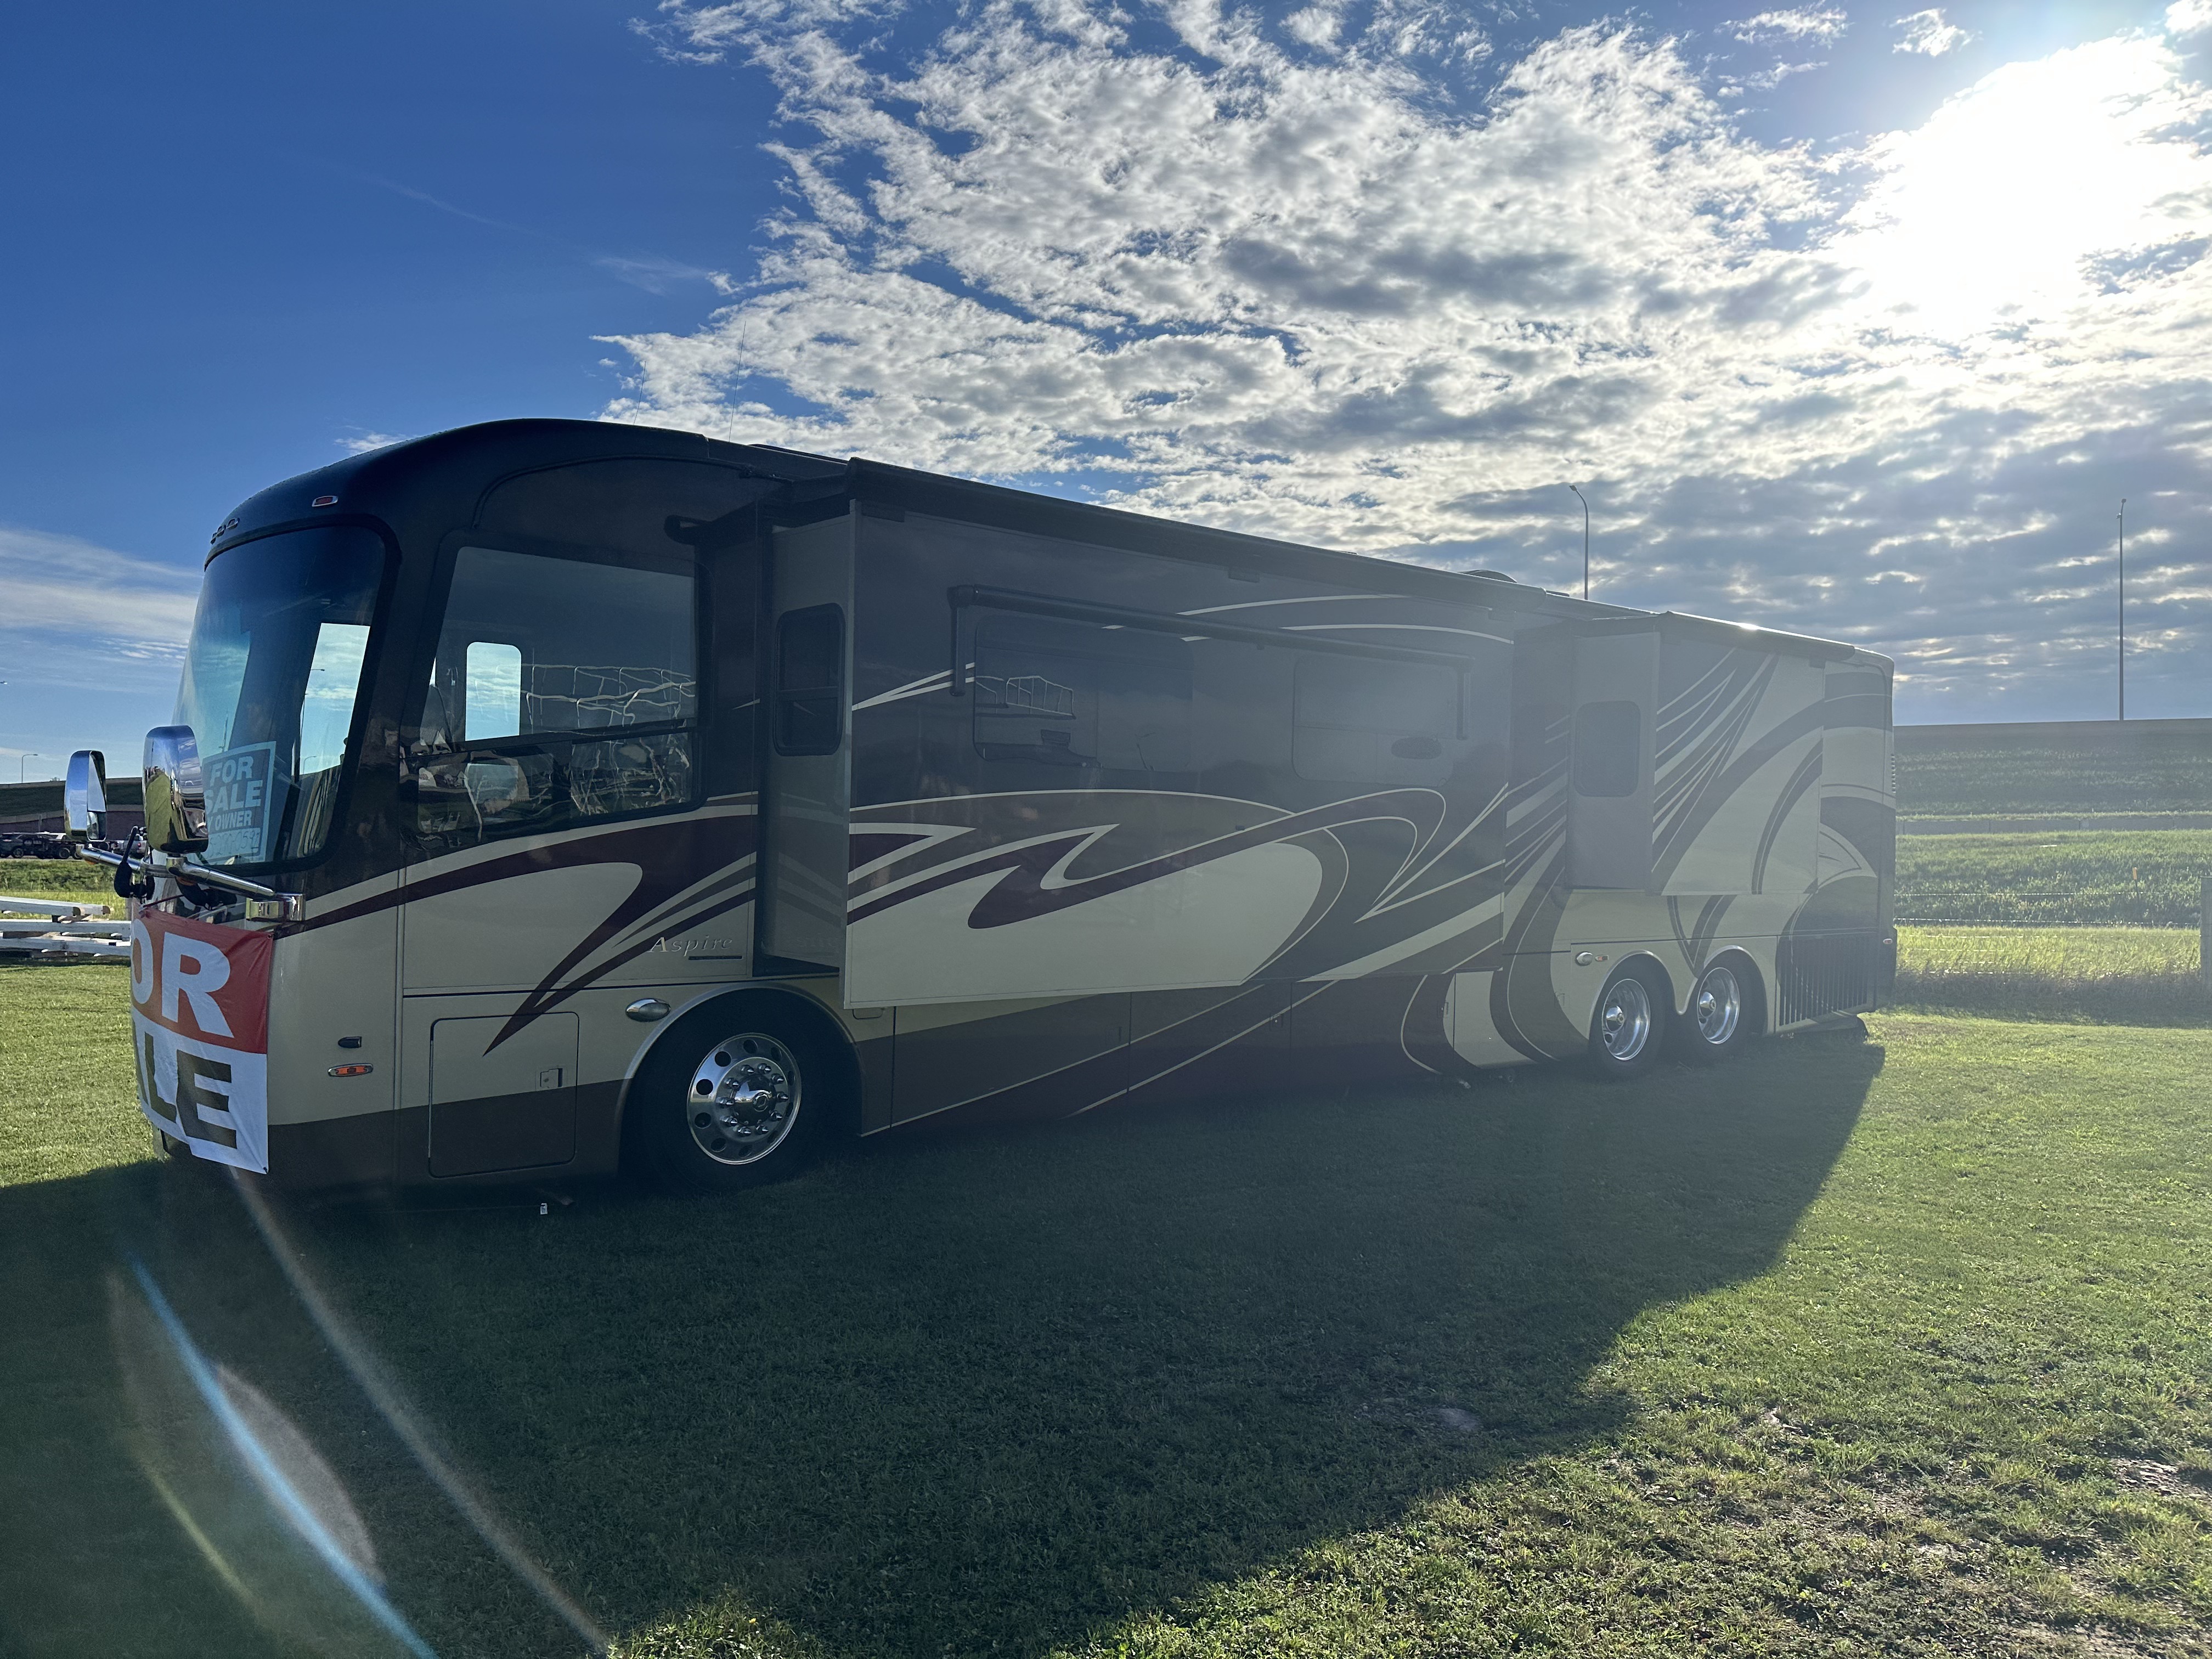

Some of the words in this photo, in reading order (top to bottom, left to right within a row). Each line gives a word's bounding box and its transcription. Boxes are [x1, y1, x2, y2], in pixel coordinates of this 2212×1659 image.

[210, 756, 254, 787] FOR
[204, 780, 263, 815] SALE
[215, 810, 252, 831] OWNER
[646, 935, 733, 957] Aspire
